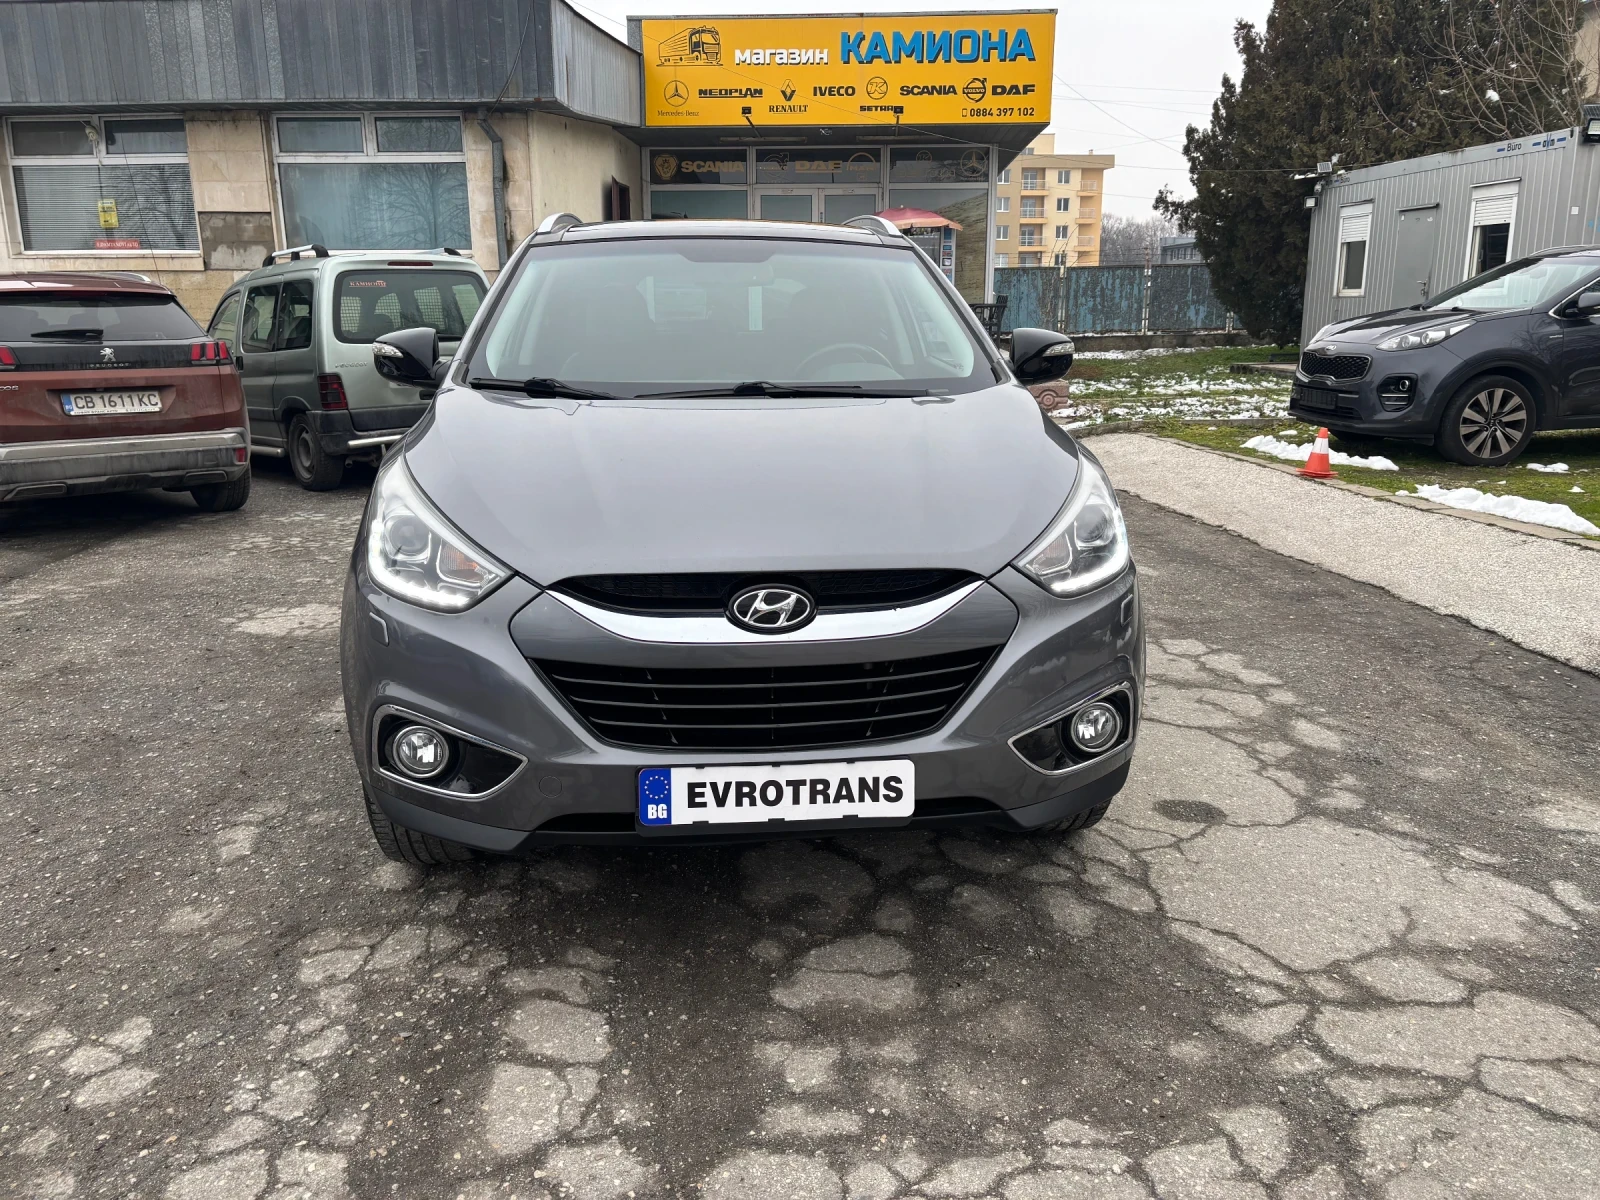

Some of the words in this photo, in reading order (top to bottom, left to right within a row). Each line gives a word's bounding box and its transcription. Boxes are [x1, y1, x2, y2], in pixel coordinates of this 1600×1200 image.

[734, 48, 829, 65] магазин
[840, 28, 1036, 64] КАМИОНА
[698, 88, 763, 98] NEOPLAN
[813, 85, 856, 97] IVECO
[899, 84, 958, 96] SCANIA
[963, 87, 985, 95] VOLVO
[991, 84, 1036, 96] DAF
[768, 104, 809, 113] RENAULT
[969, 108, 994, 117] 0884
[996, 108, 1014, 116] 397
[1017, 107, 1035, 116] 102
[1506, 142, 1522, 152] Büro
[680, 160, 745, 173] SCANIA
[795, 160, 843, 171] DAF
[73, 395, 95, 409] CB
[99, 393, 135, 408] 1611
[137, 393, 158, 406] KC
[686, 775, 904, 808] EVROTRANS
[647, 804, 668, 819] BG
